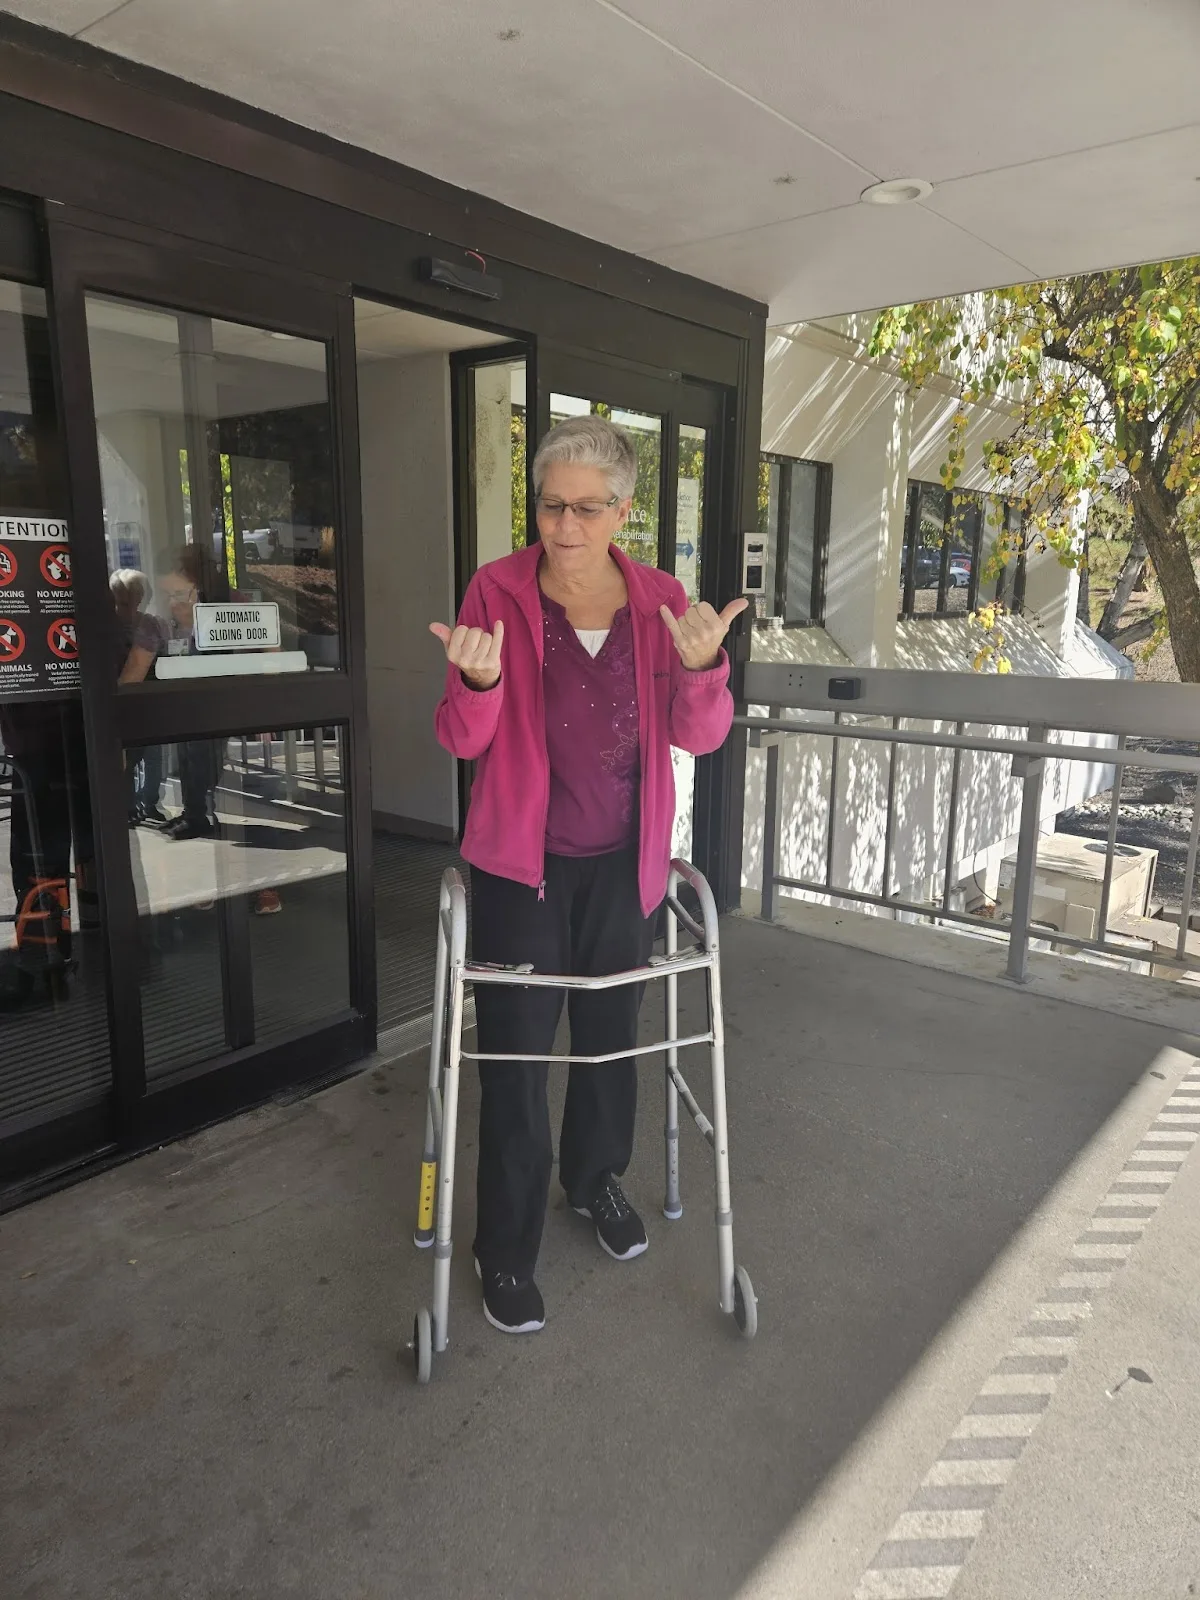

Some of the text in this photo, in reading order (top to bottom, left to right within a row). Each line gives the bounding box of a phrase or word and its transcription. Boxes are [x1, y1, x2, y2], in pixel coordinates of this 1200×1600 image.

[37, 590, 50, 598] NO
[215, 611, 260, 623] AUTOMATIC
[209, 628, 268, 641] SLIDING DOOR
[45, 663, 58, 671] NO
